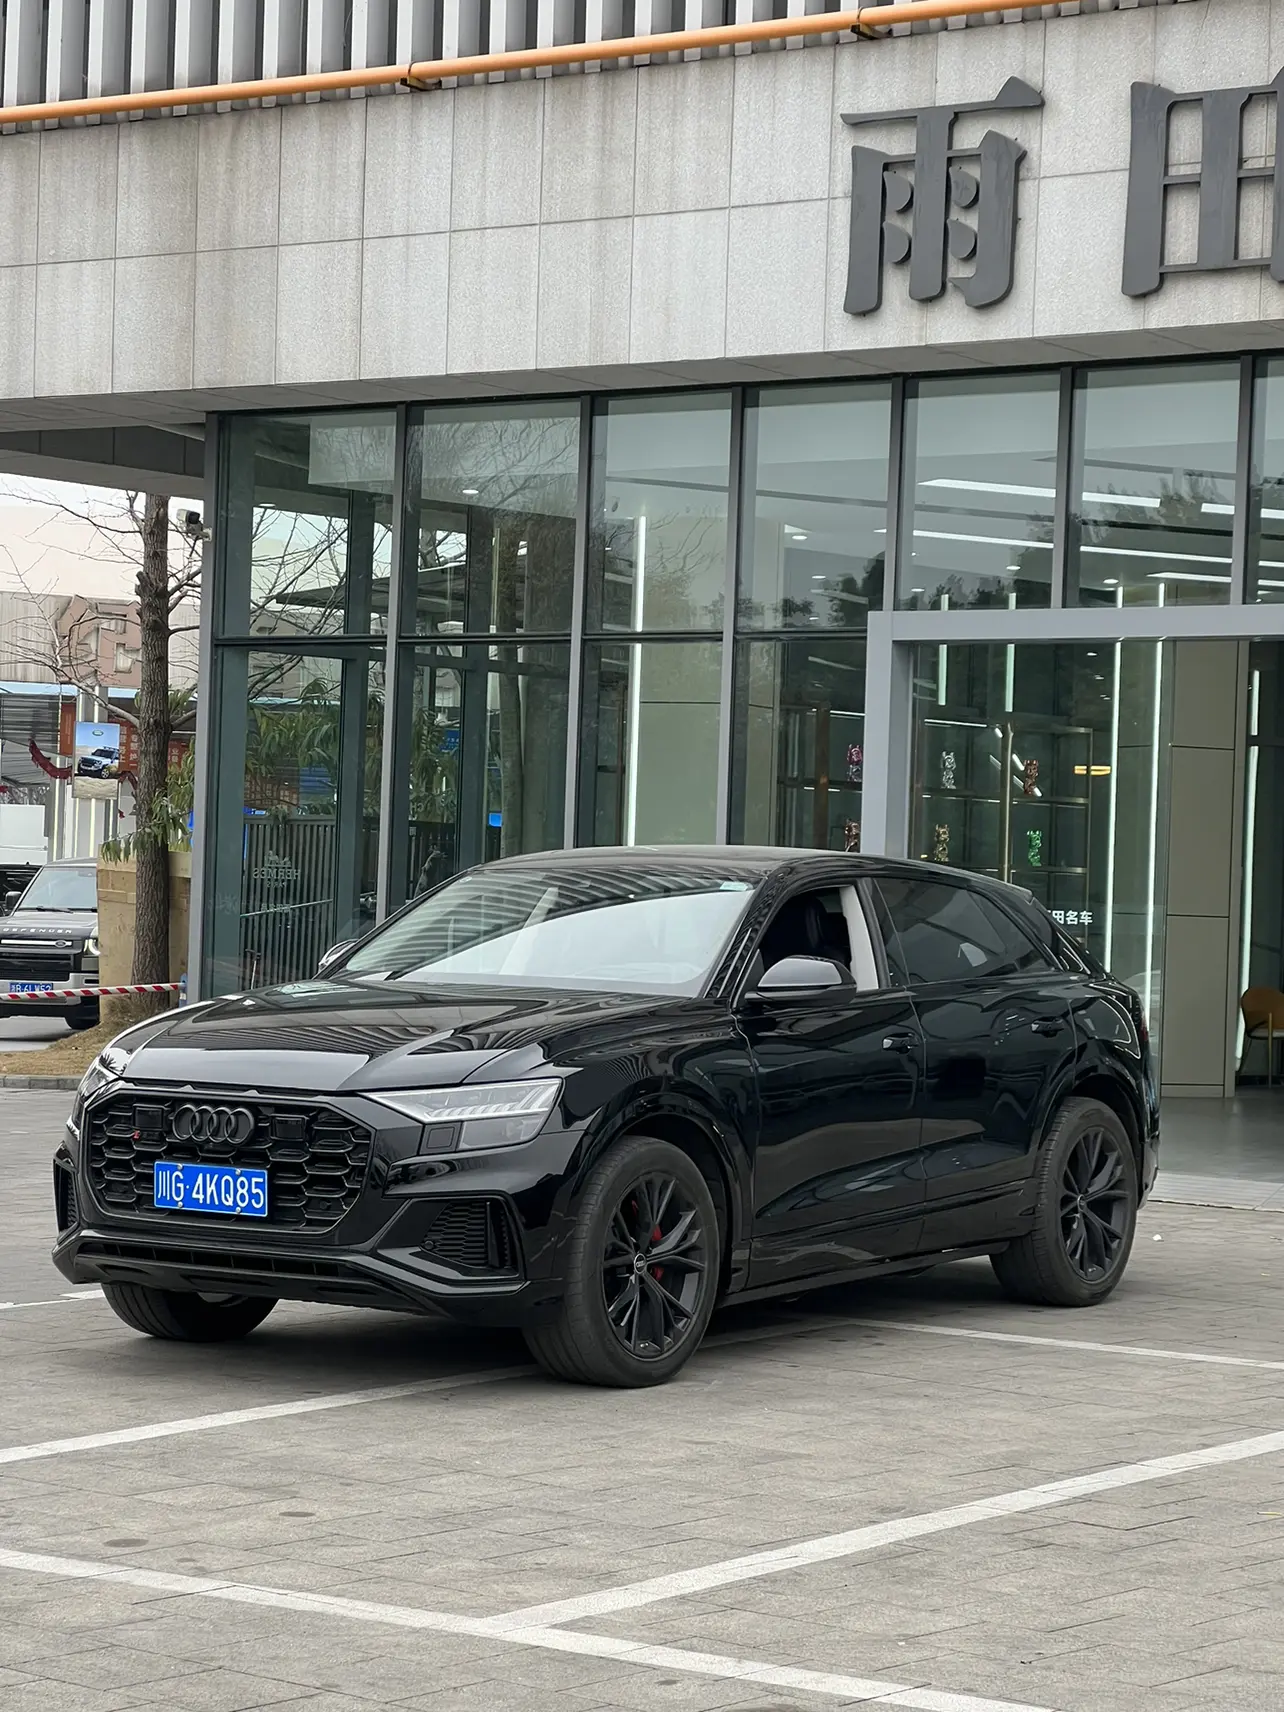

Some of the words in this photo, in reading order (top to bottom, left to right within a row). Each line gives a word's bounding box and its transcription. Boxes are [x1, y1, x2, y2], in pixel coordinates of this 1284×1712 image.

[840, 67, 1284, 315] 雨田
[1047, 909, 1093, 926] 田名车
[157, 1169, 264, 1209] 川G·4KQ85
